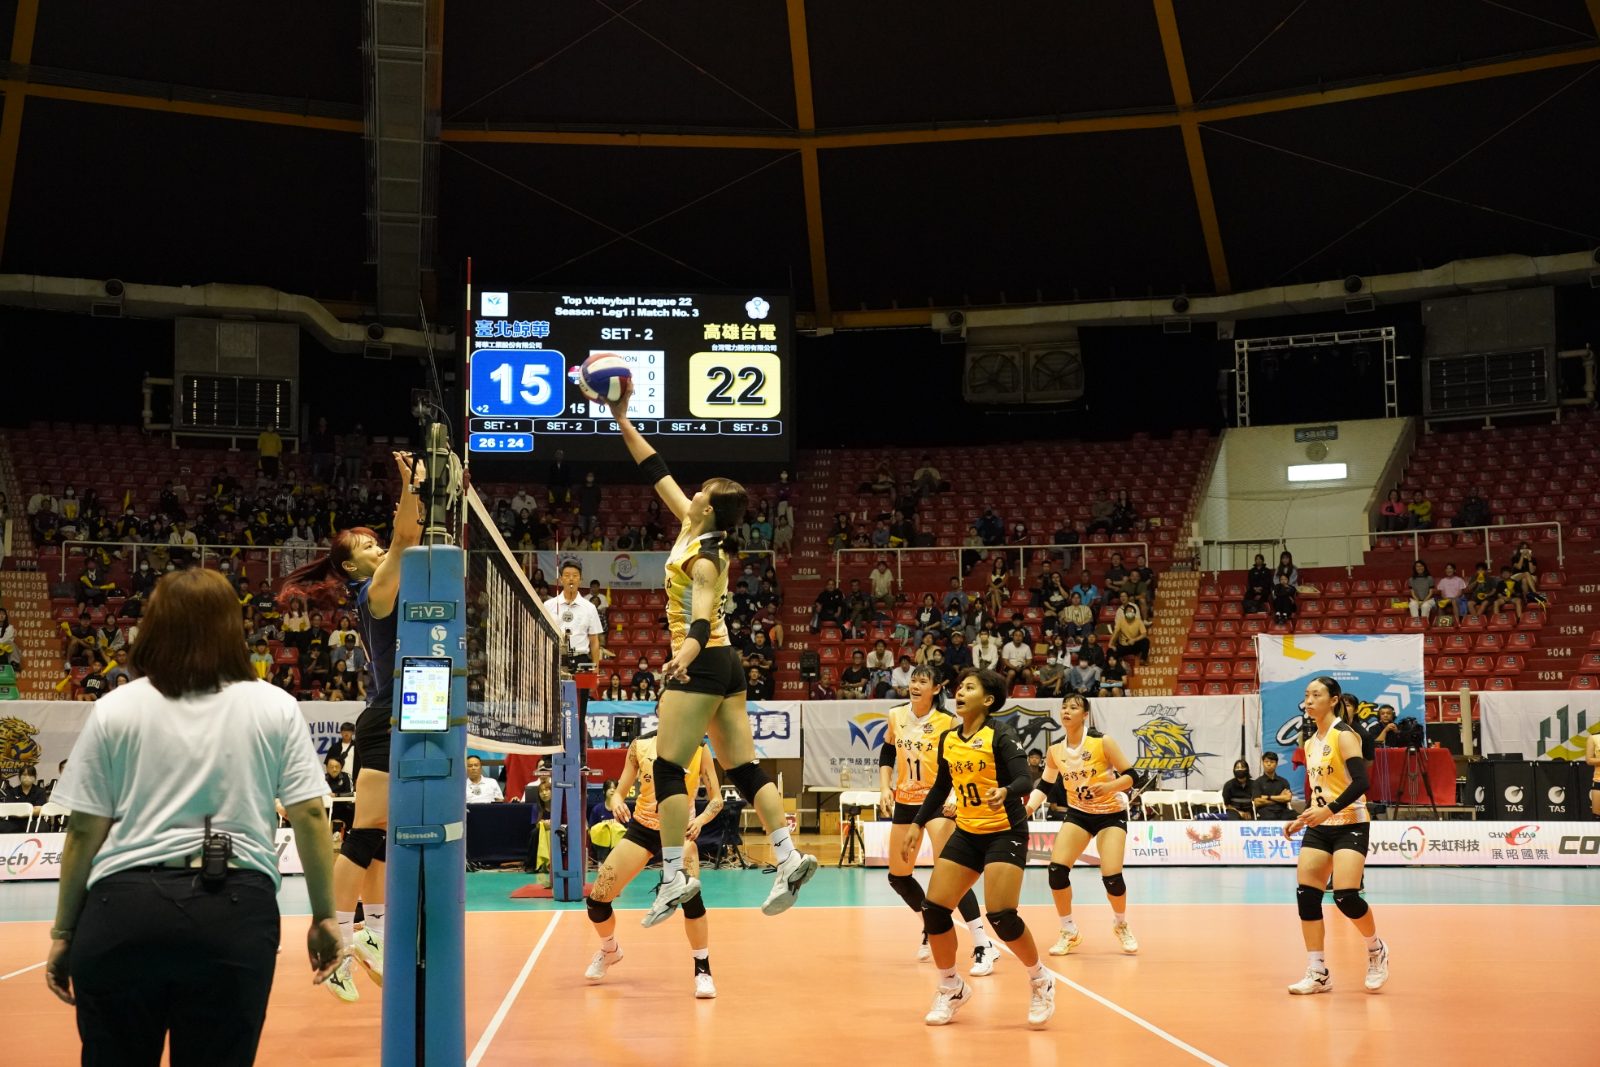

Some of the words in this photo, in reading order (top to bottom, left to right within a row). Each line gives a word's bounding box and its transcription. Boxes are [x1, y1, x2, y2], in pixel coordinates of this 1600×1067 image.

[562, 296, 582, 306] Top
[584, 296, 635, 307] Volleyball
[637, 297, 677, 307] League
[678, 297, 692, 306] 22
[555, 307, 594, 316] Season
[602, 307, 628, 318] Leg1
[637, 308, 670, 317] Match
[672, 308, 690, 317] No.
[692, 309, 699, 317] 3
[475, 320, 550, 338] 臺北鯨華
[601, 328, 631, 340] SET
[644, 328, 653, 340] 2
[703, 323, 776, 340] 高雄台電
[648, 354, 655, 364] 0
[648, 371, 655, 381] 0
[489, 363, 552, 405] 15
[705, 366, 766, 405] 22
[648, 388, 655, 397] 2
[476, 404, 489, 413] +2
[569, 403, 585, 414] 15
[648, 404, 655, 414] 0
[484, 422, 504, 430] SET
[514, 422, 518, 430] 1
[546, 422, 568, 431] SET
[575, 423, 582, 431] 2
[638, 423, 644, 431] 3
[671, 423, 692, 431] SET
[700, 423, 706, 431] 4
[733, 423, 754, 432] SET
[762, 423, 768, 432] 5
[479, 438, 496, 448] 26
[507, 438, 524, 448] 24
[907, 758, 921, 781] 11
[959, 783, 982, 808] 19
[1428, 839, 1480, 852] 天虹科技
[1132, 848, 1168, 857] TAIPEI
